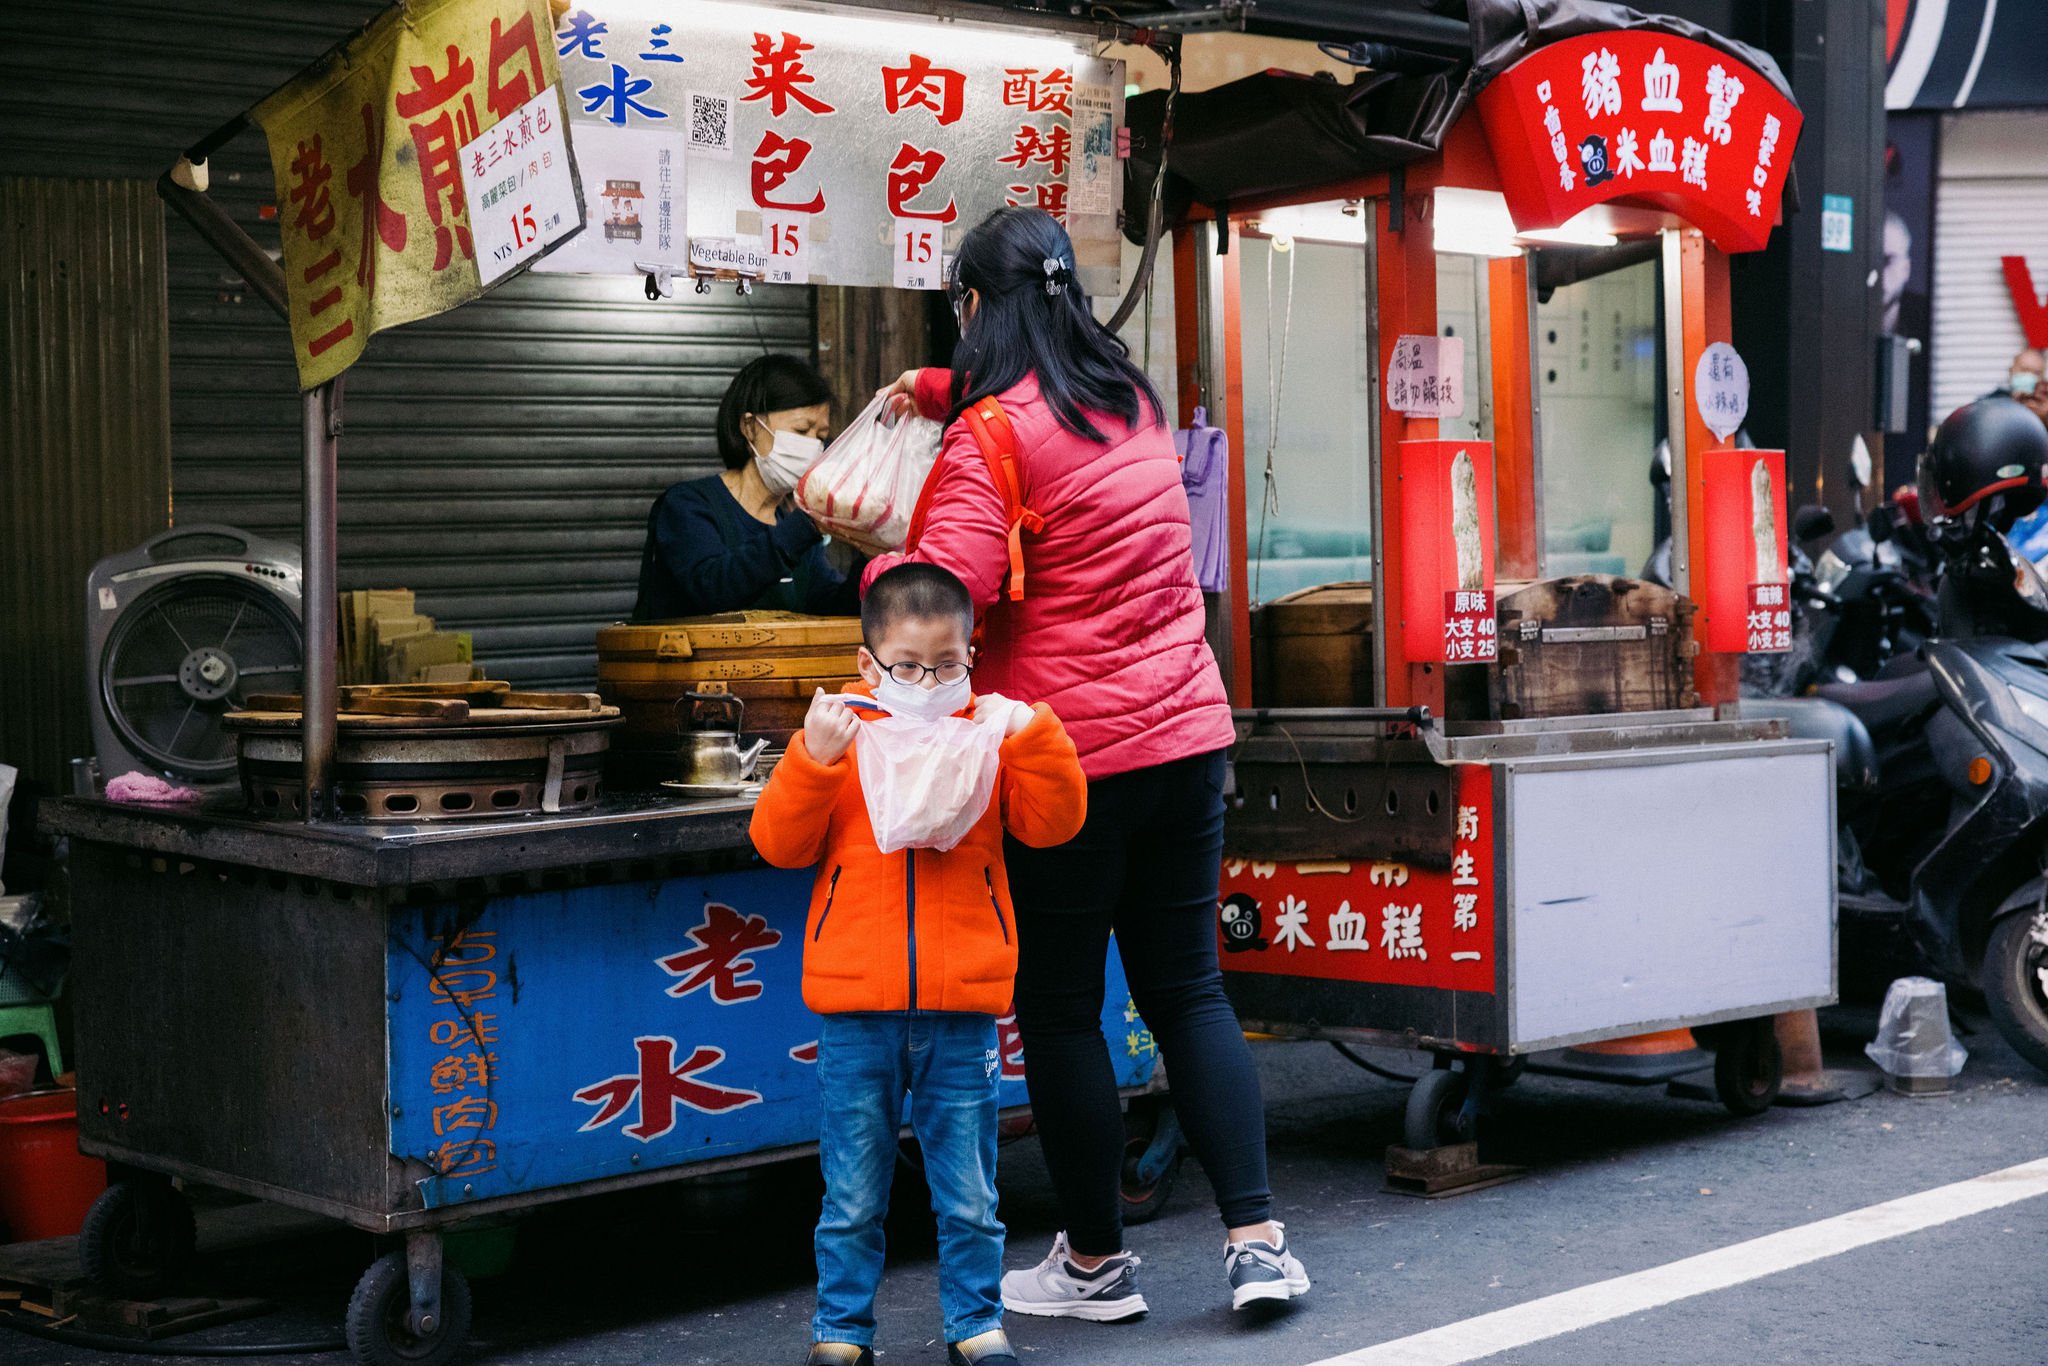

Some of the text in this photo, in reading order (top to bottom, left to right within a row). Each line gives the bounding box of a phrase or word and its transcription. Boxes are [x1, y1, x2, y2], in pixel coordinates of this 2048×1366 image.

[557, 9, 685, 62] 老三
[578, 64, 669, 125] 水
[472, 105, 552, 178] 老三水煎包
[740, 31, 836, 214] 菜包
[881, 53, 966, 225] 肉包
[1616, 127, 1708, 191] 米血糕
[658, 148, 671, 251] 請往左邊排隊
[511, 204, 537, 251] 15
[770, 223, 799, 256] 15
[904, 232, 932, 263] 15
[691, 243, 745, 265] Vegetable
[1455, 589, 1487, 613] 原味
[1747, 610, 1790, 630] 大支 40
[1445, 617, 1495, 638] 大支 40
[1445, 638, 1495, 659] 小支 25
[1748, 630, 1790, 649] 小支 25
[1273, 894, 1428, 961] 米血糕
